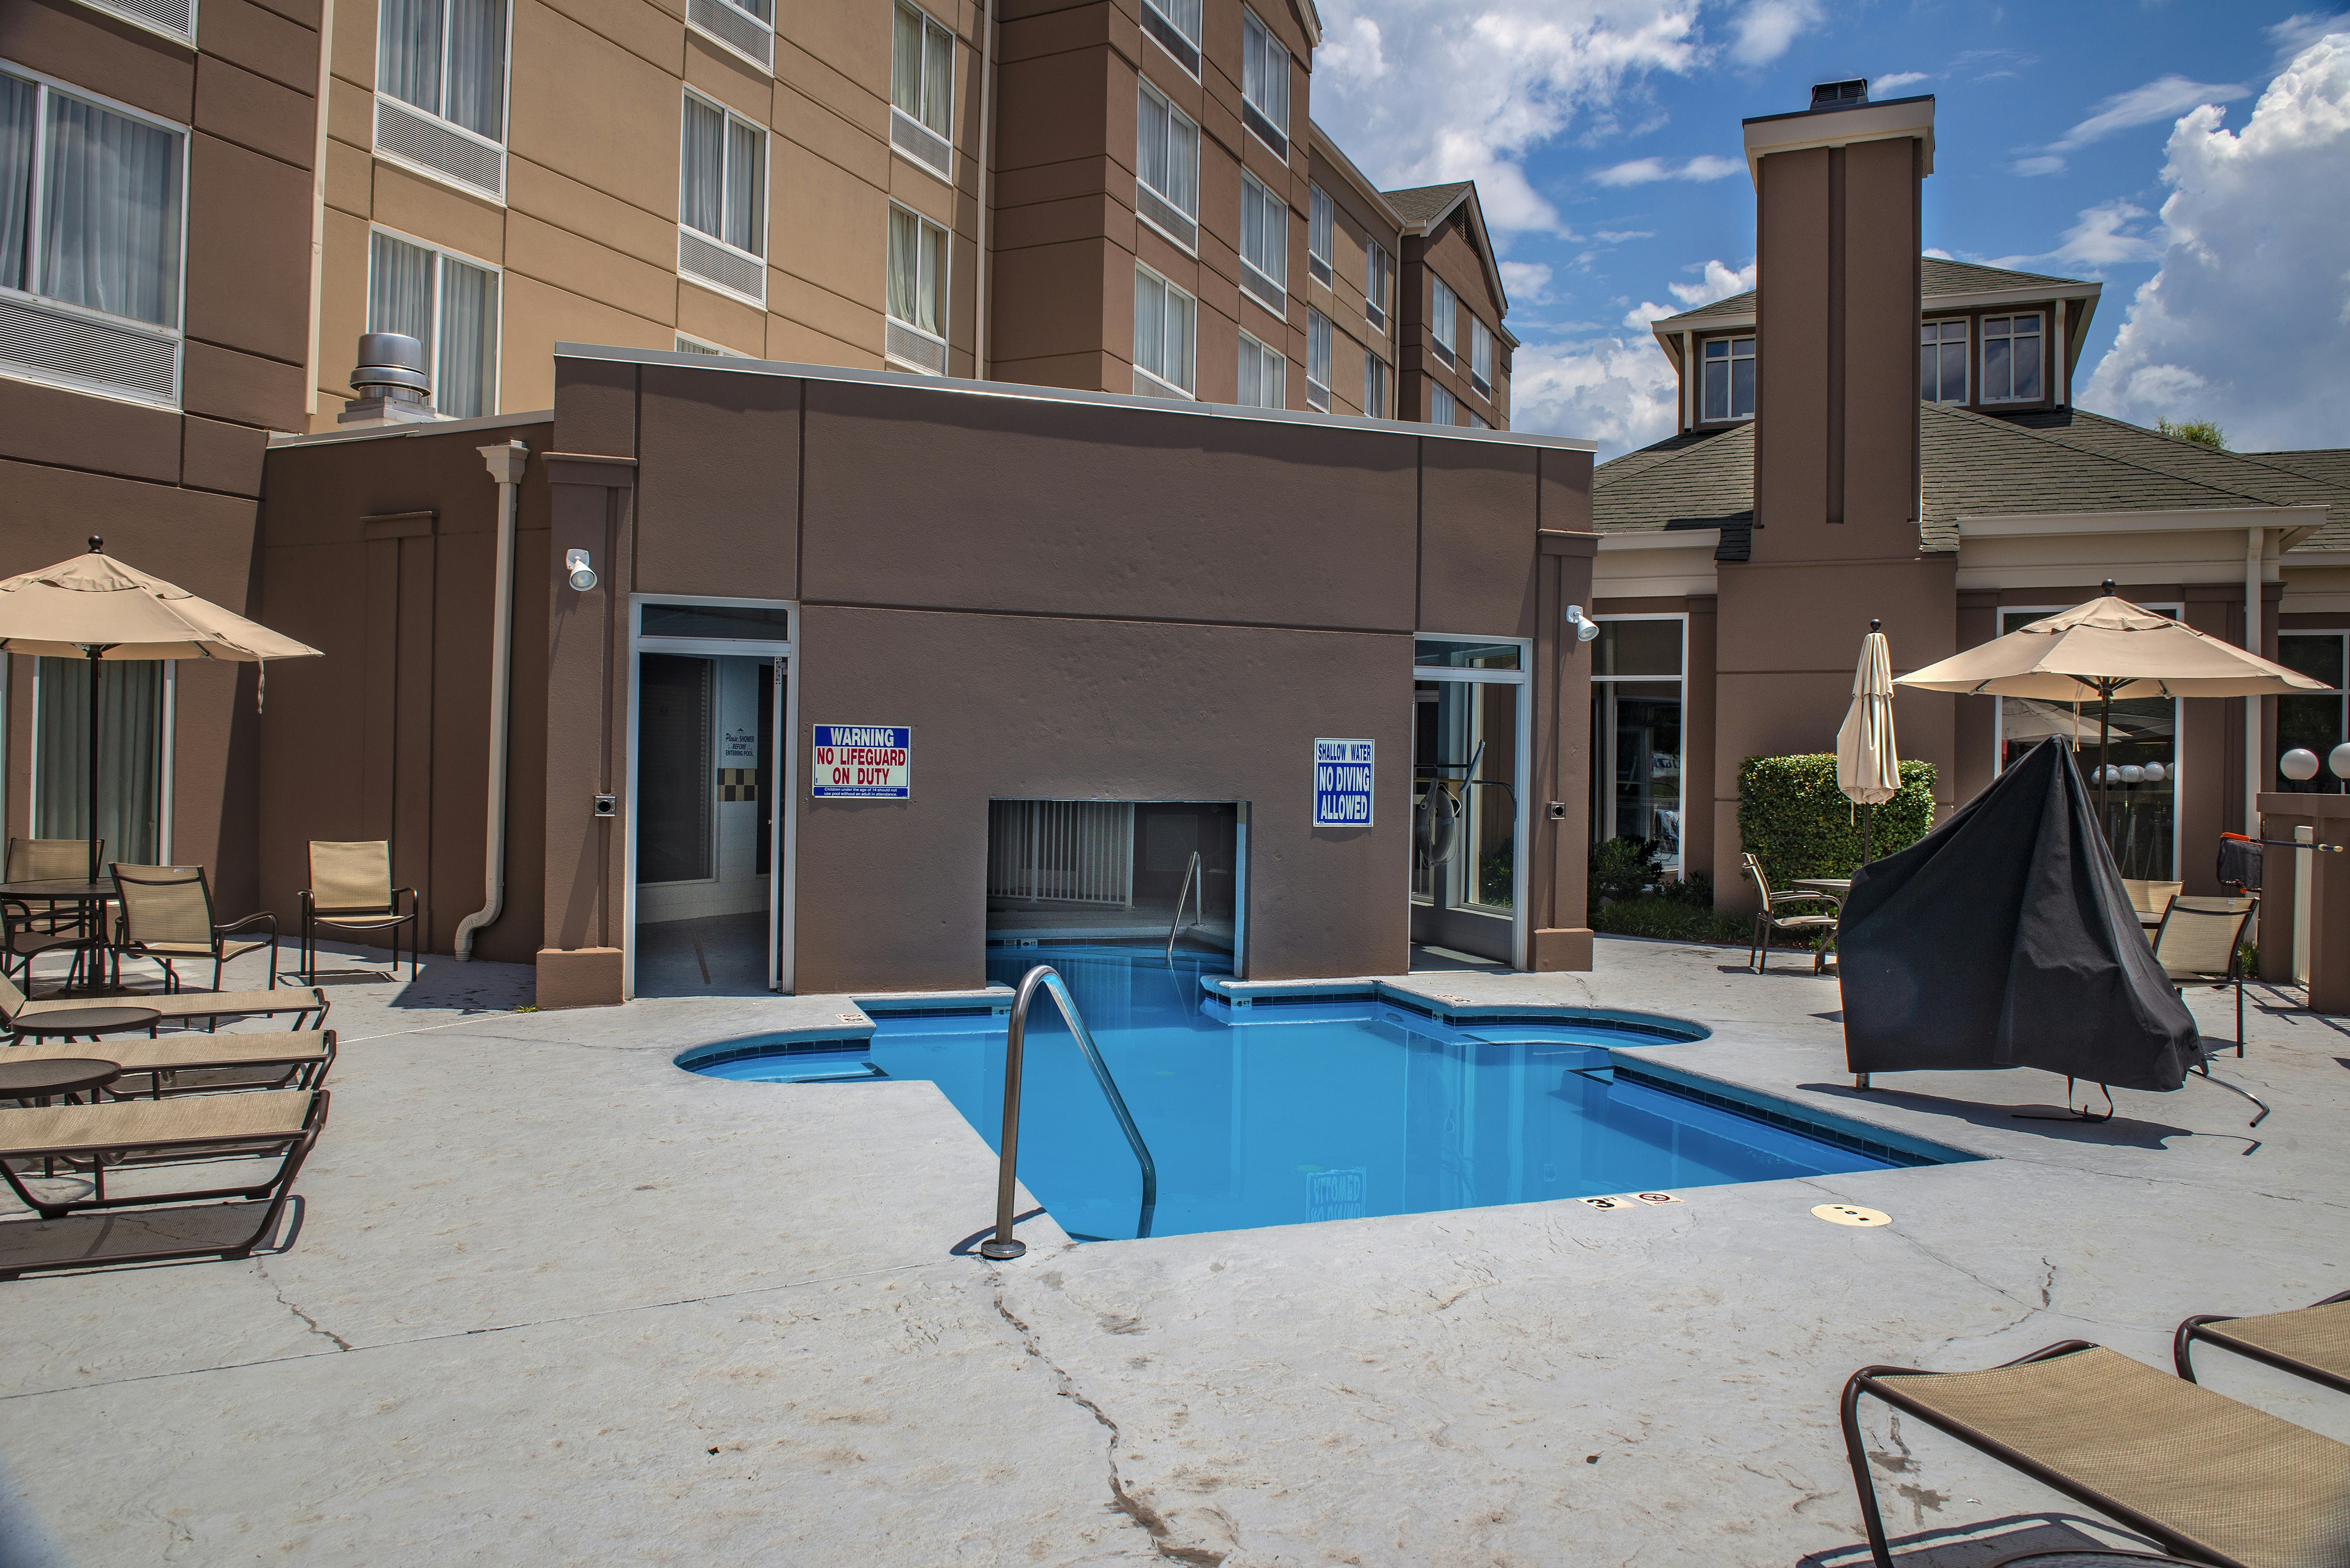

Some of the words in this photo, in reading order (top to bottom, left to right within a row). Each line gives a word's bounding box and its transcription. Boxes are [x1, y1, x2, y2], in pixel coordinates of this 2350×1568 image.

[726, 733, 738, 742] Please
[830, 728, 894, 746] WARNING
[817, 747, 834, 765] NO
[840, 748, 906, 766] LIFEGUARD
[1319, 743, 1346, 760] SHALLOW
[1351, 744, 1371, 761] WATER
[833, 767, 850, 784] ON
[857, 768, 890, 785] DUTY
[1319, 766, 1334, 791] NO
[1336, 767, 1370, 792] DIVING
[1321, 794, 1367, 820] ALLOWED
[1587, 1199, 1615, 1208] 3
